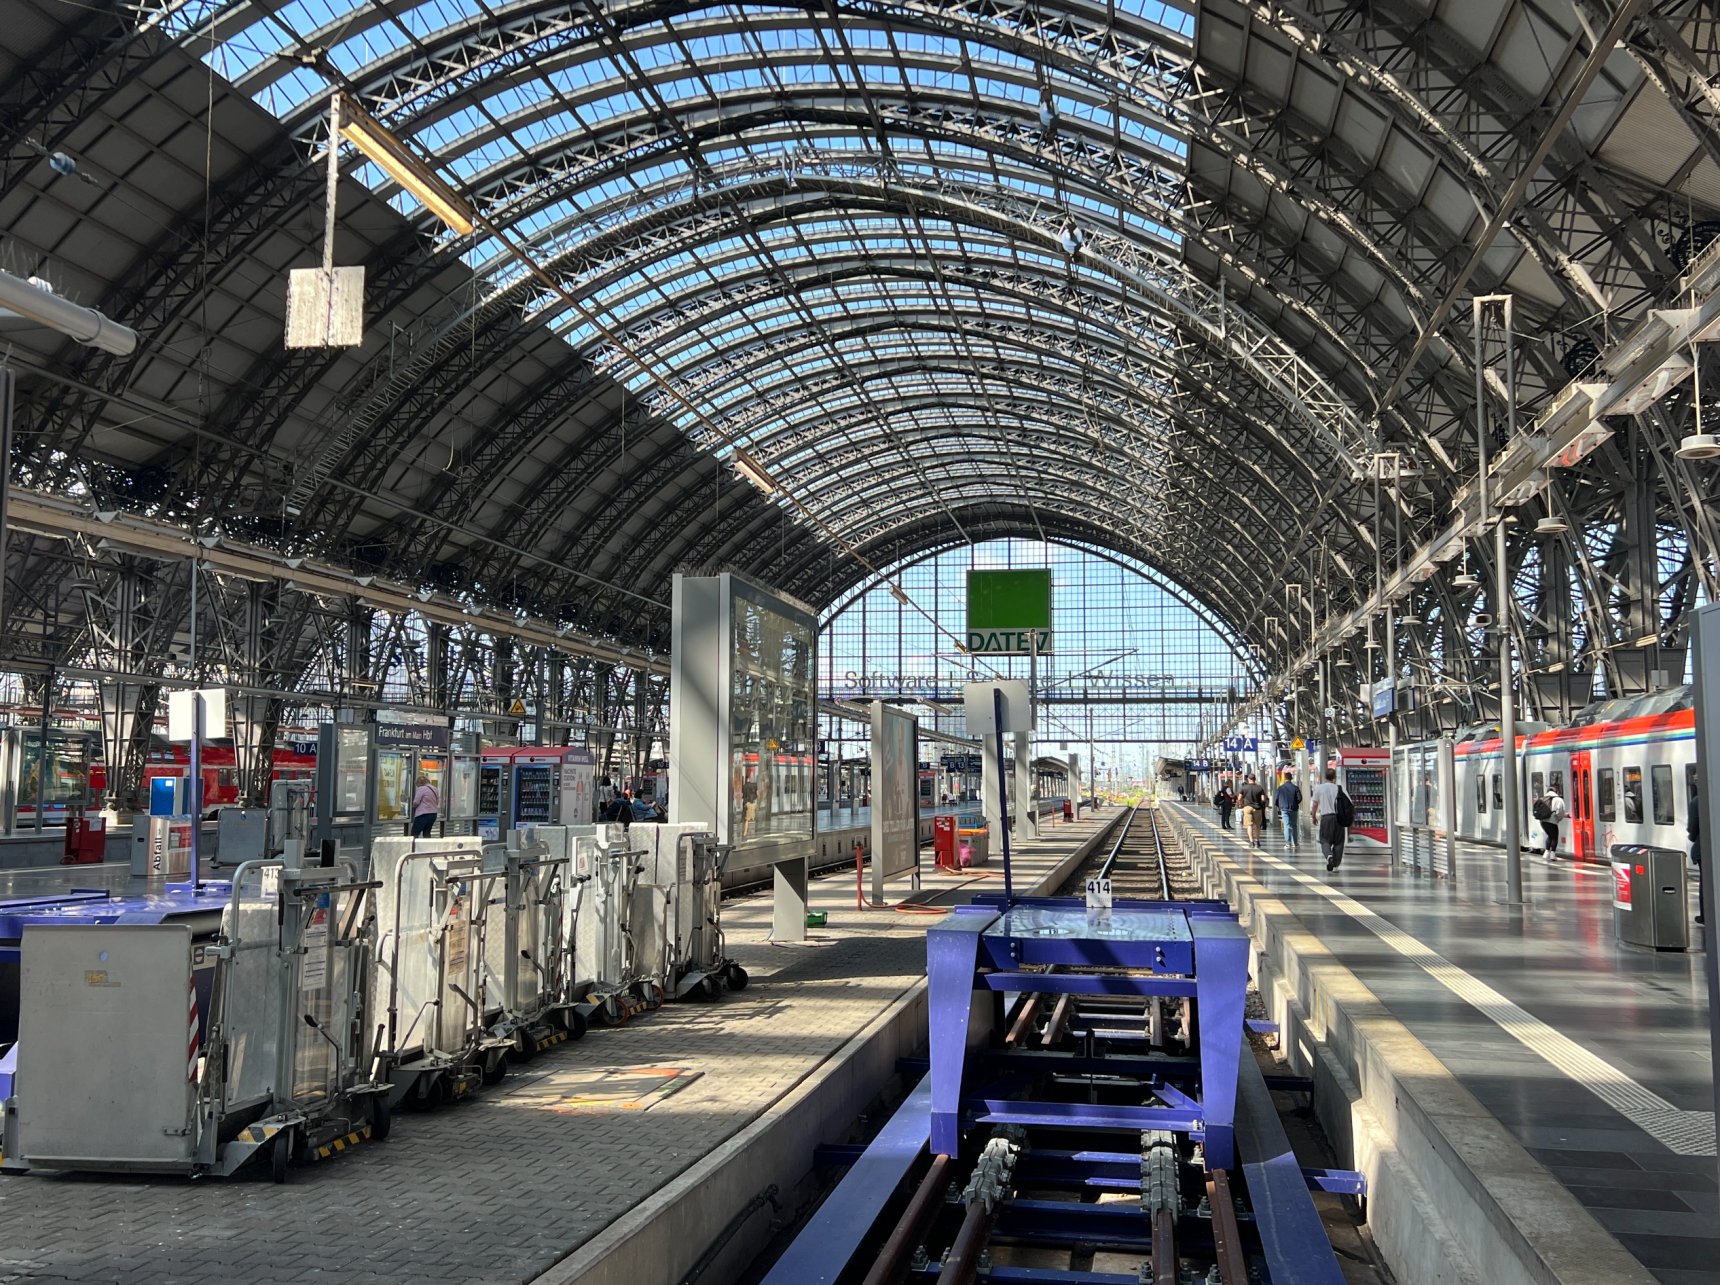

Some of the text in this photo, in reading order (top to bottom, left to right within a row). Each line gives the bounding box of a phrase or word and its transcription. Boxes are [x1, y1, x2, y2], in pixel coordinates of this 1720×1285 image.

[844, 670, 1174, 689] Software Wissen
[378, 726, 404, 739] Frankfurt
[412, 731, 422, 740] Main
[422, 729, 433, 740] Hbf
[295, 743, 317, 754] 10 A
[1225, 738, 1254, 749] 14 A
[153, 837, 162, 871] Abfall
[263, 868, 279, 879] 413
[1087, 881, 1111, 894] 414
